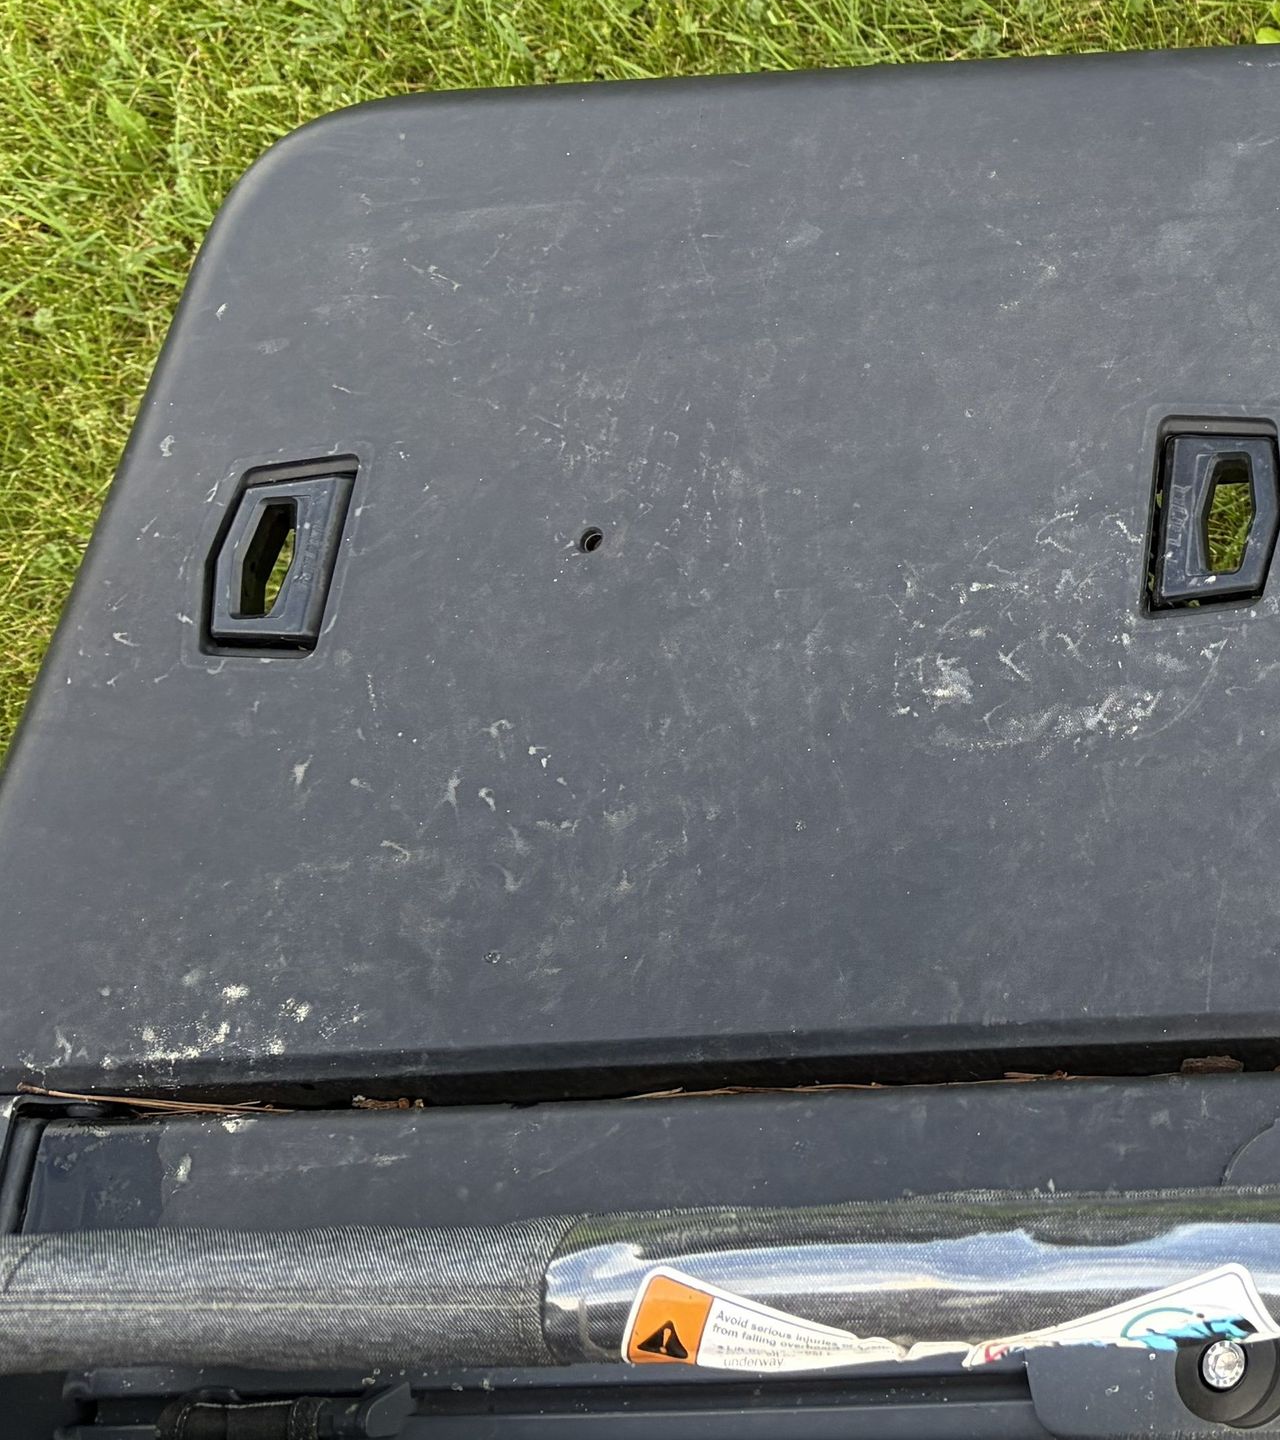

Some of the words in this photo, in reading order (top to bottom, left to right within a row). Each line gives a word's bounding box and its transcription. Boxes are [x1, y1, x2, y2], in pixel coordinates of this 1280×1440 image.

[712, 1323, 738, 1338] from
[742, 1331, 776, 1347] falling
[716, 1309, 749, 1329] Avoid
[751, 1323, 792, 1340] serious
[795, 1333, 838, 1347] injuries
[723, 1356, 784, 1368] underway
